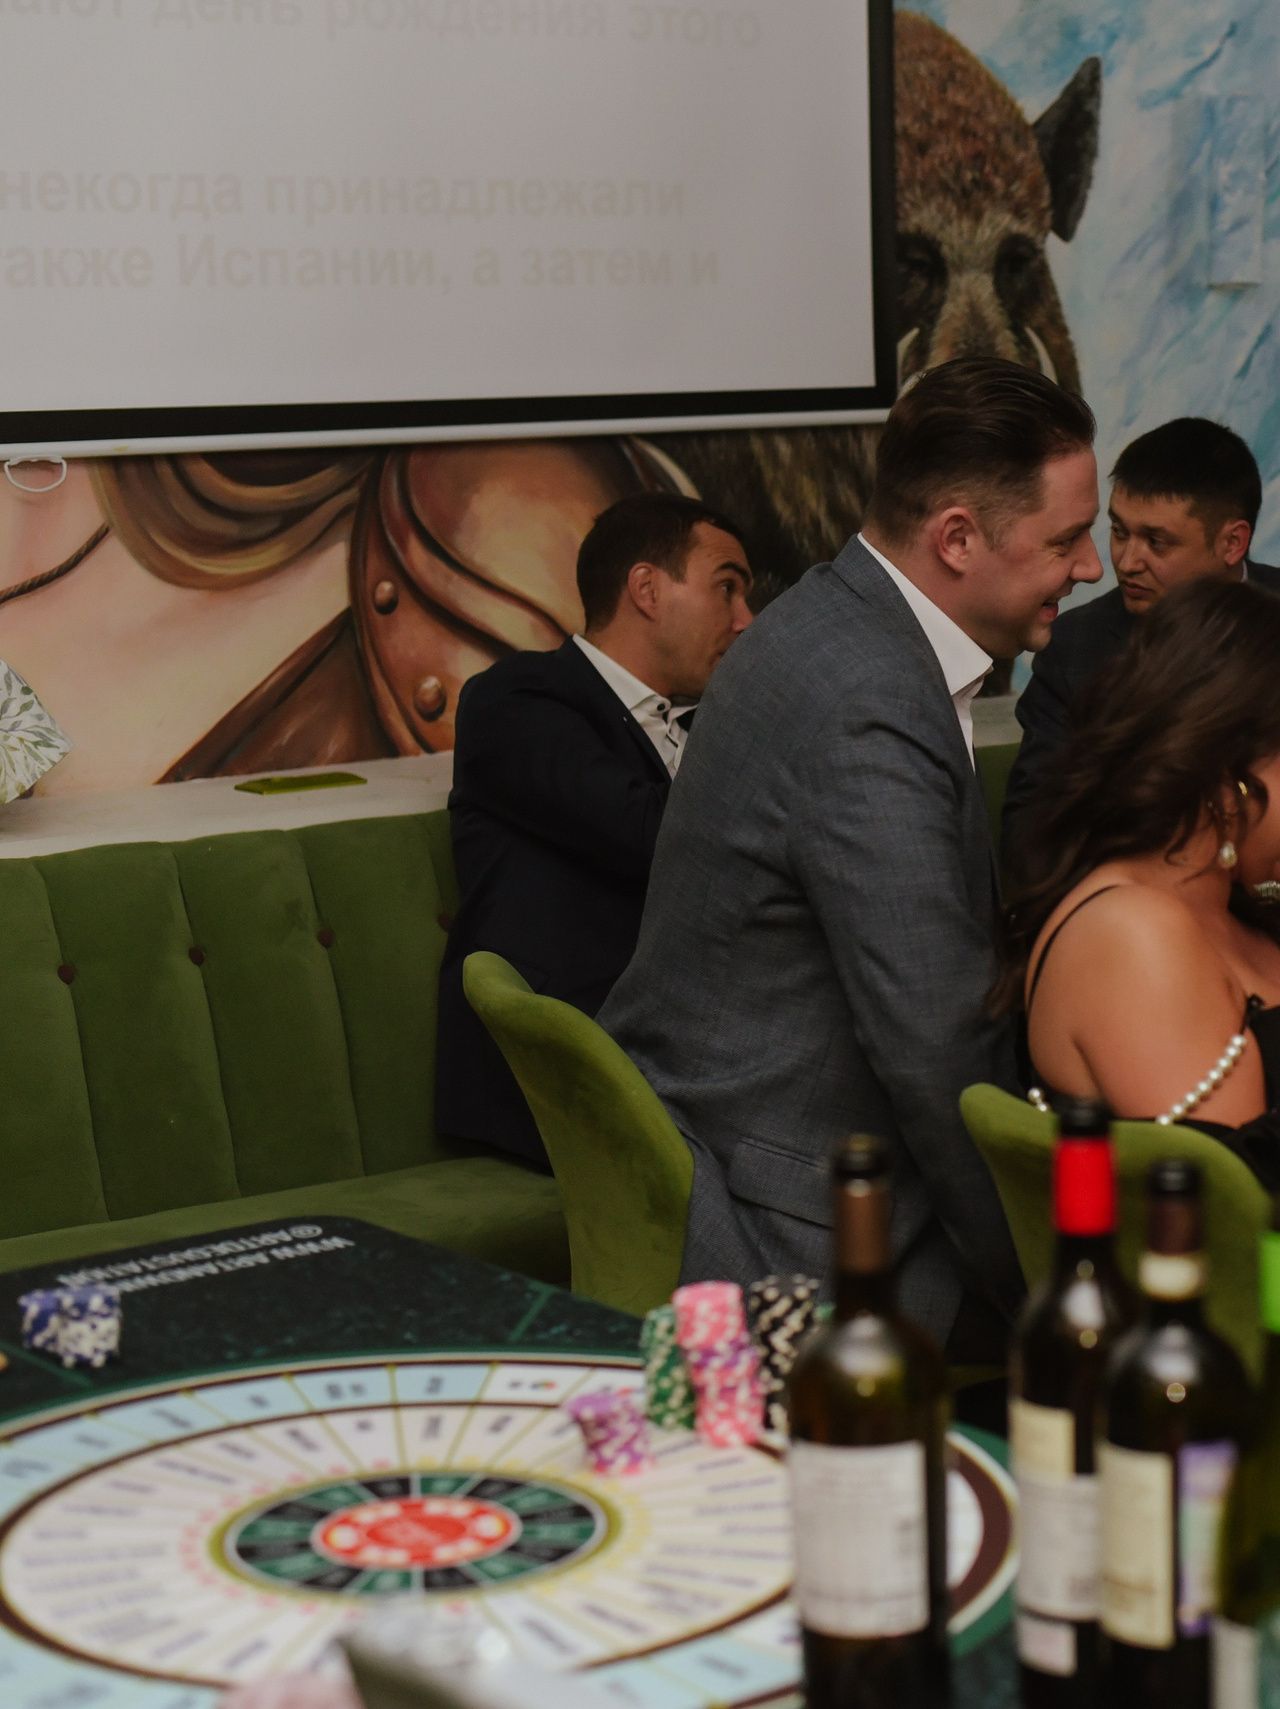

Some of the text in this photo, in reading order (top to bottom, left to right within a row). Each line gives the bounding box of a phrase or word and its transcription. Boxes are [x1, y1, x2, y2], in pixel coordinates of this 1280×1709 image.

[628, 3, 764, 48] этого
[0, 171, 687, 228] некогда принадлежали
[2, 233, 719, 296] акже Испании, а затем и
